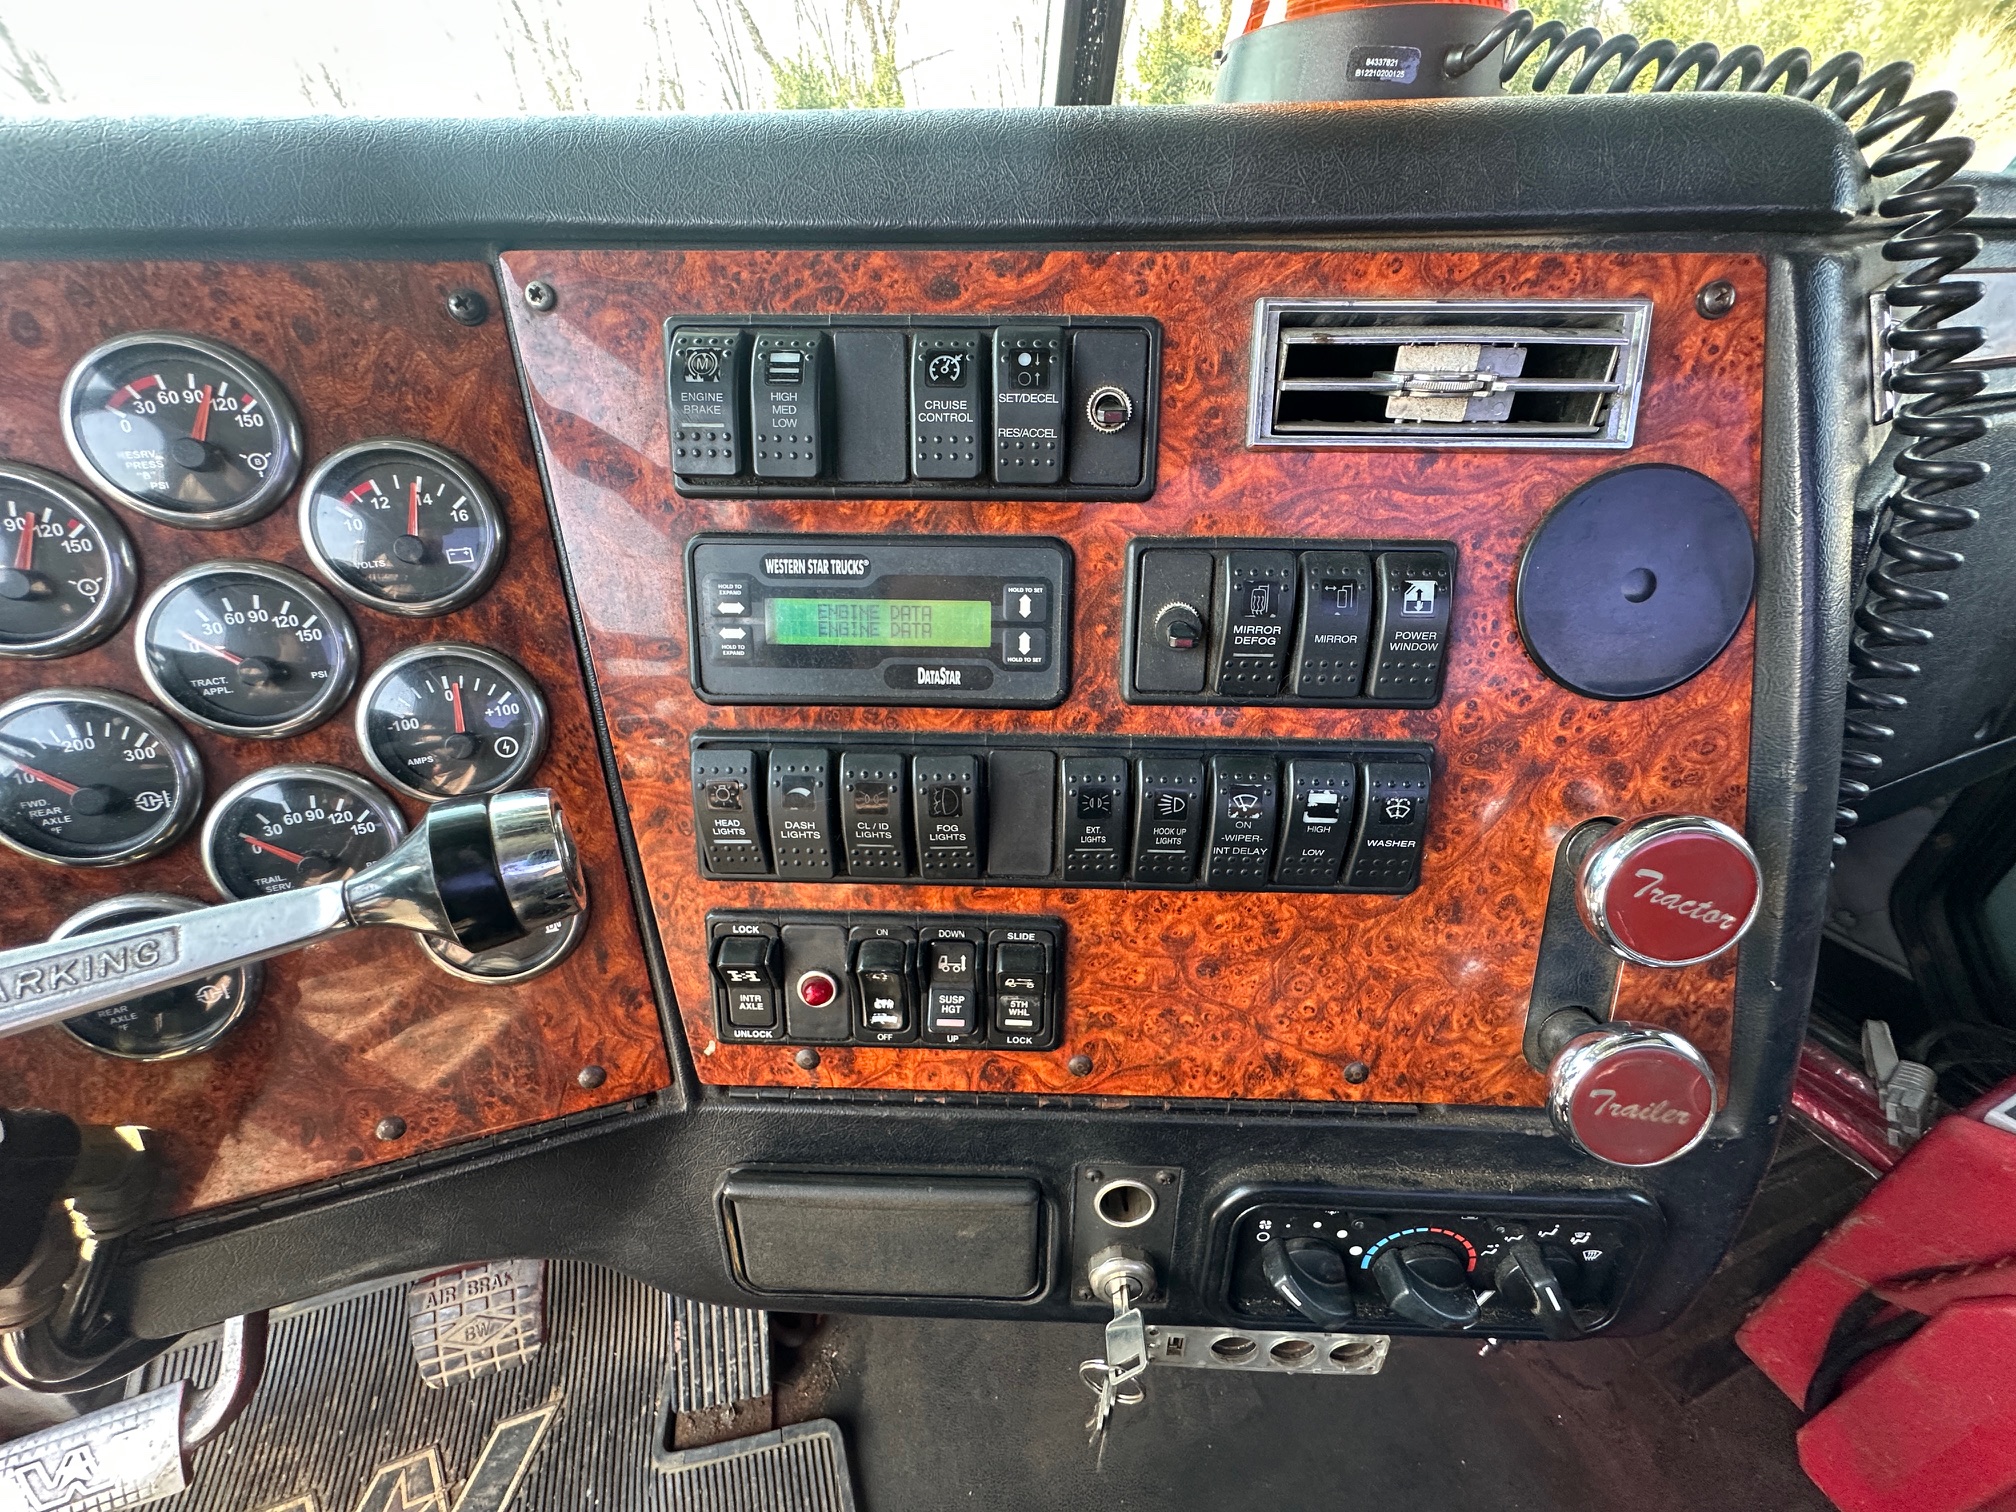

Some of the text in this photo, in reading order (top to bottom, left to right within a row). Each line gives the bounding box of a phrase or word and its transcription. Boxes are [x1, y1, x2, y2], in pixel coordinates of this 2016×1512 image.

[681, 392, 723, 402] ENGINE
[770, 392, 798, 402] HIGH
[998, 393, 1059, 404] SET/DECEL
[683, 405, 721, 415] BRAKE
[772, 405, 797, 415] MED
[925, 400, 968, 410] CRUISE
[120, 390, 264, 433] 0 30 60 90 120 150
[918, 413, 973, 423] CONTROL
[772, 419, 798, 428] LOW
[998, 428, 1057, 438] RES/ACCEL
[150, 481, 170, 489] PSI
[343, 518, 363, 532] 10
[370, 498, 391, 510] 12
[450, 509, 469, 523] 16
[4, 518, 92, 553] 90 120 150
[354, 560, 386, 570] VOLTS
[765, 558, 806, 574] WESTERN
[807, 559, 829, 574] STAR
[890, 606, 932, 621] DATA
[202, 622, 223, 635] 30
[224, 612, 245, 625] 60
[249, 610, 269, 622] 90
[272, 615, 299, 628] 120
[296, 628, 322, 642] 150
[890, 622, 932, 638] DATA
[1233, 625, 1281, 635] MIRROR
[1314, 635, 1358, 644] MIRROR
[1395, 631, 1437, 640] POWER
[1234, 636, 1276, 646] DEFOG
[1389, 642, 1438, 651] WINDOW
[311, 670, 328, 679] PSI
[203, 687, 234, 695] APPL.
[444, 691, 453, 701] 0
[62, 737, 95, 753] 200
[124, 747, 156, 762] 300
[407, 756, 434, 767] AMPS
[29, 807, 62, 819] REAR
[42, 815, 72, 826] AXLE
[262, 824, 283, 837] 30
[283, 813, 303, 826] 60
[305, 809, 325, 822] 90
[328, 811, 353, 825] 120
[350, 822, 376, 836] 150
[1235, 821, 1251, 829] ON
[712, 828, 746, 836] LIGHTS
[780, 831, 821, 839] LIGHTS
[1086, 826, 1102, 834] EXT.
[1367, 840, 1416, 848] WASHER
[1213, 847, 1268, 856] INT DELAY
[1634, 868, 1737, 930] Tractor
[732, 926, 759, 934] LOCK
[938, 930, 965, 938] DOWN
[1007, 932, 1035, 941] SLIDE
[939, 995, 965, 1004] SUSP
[739, 1002, 764, 1010] AXLE
[941, 1005, 962, 1013] HGT
[98, 1005, 128, 1018] REAR
[110, 1012, 137, 1025] AXLE
[734, 1030, 772, 1038] UNLOCK
[947, 1035, 959, 1043] UP
[1589, 1088, 1691, 1126] Trailer
[426, 1286, 457, 1309] AIR
[464, 1322, 491, 1342] BW
